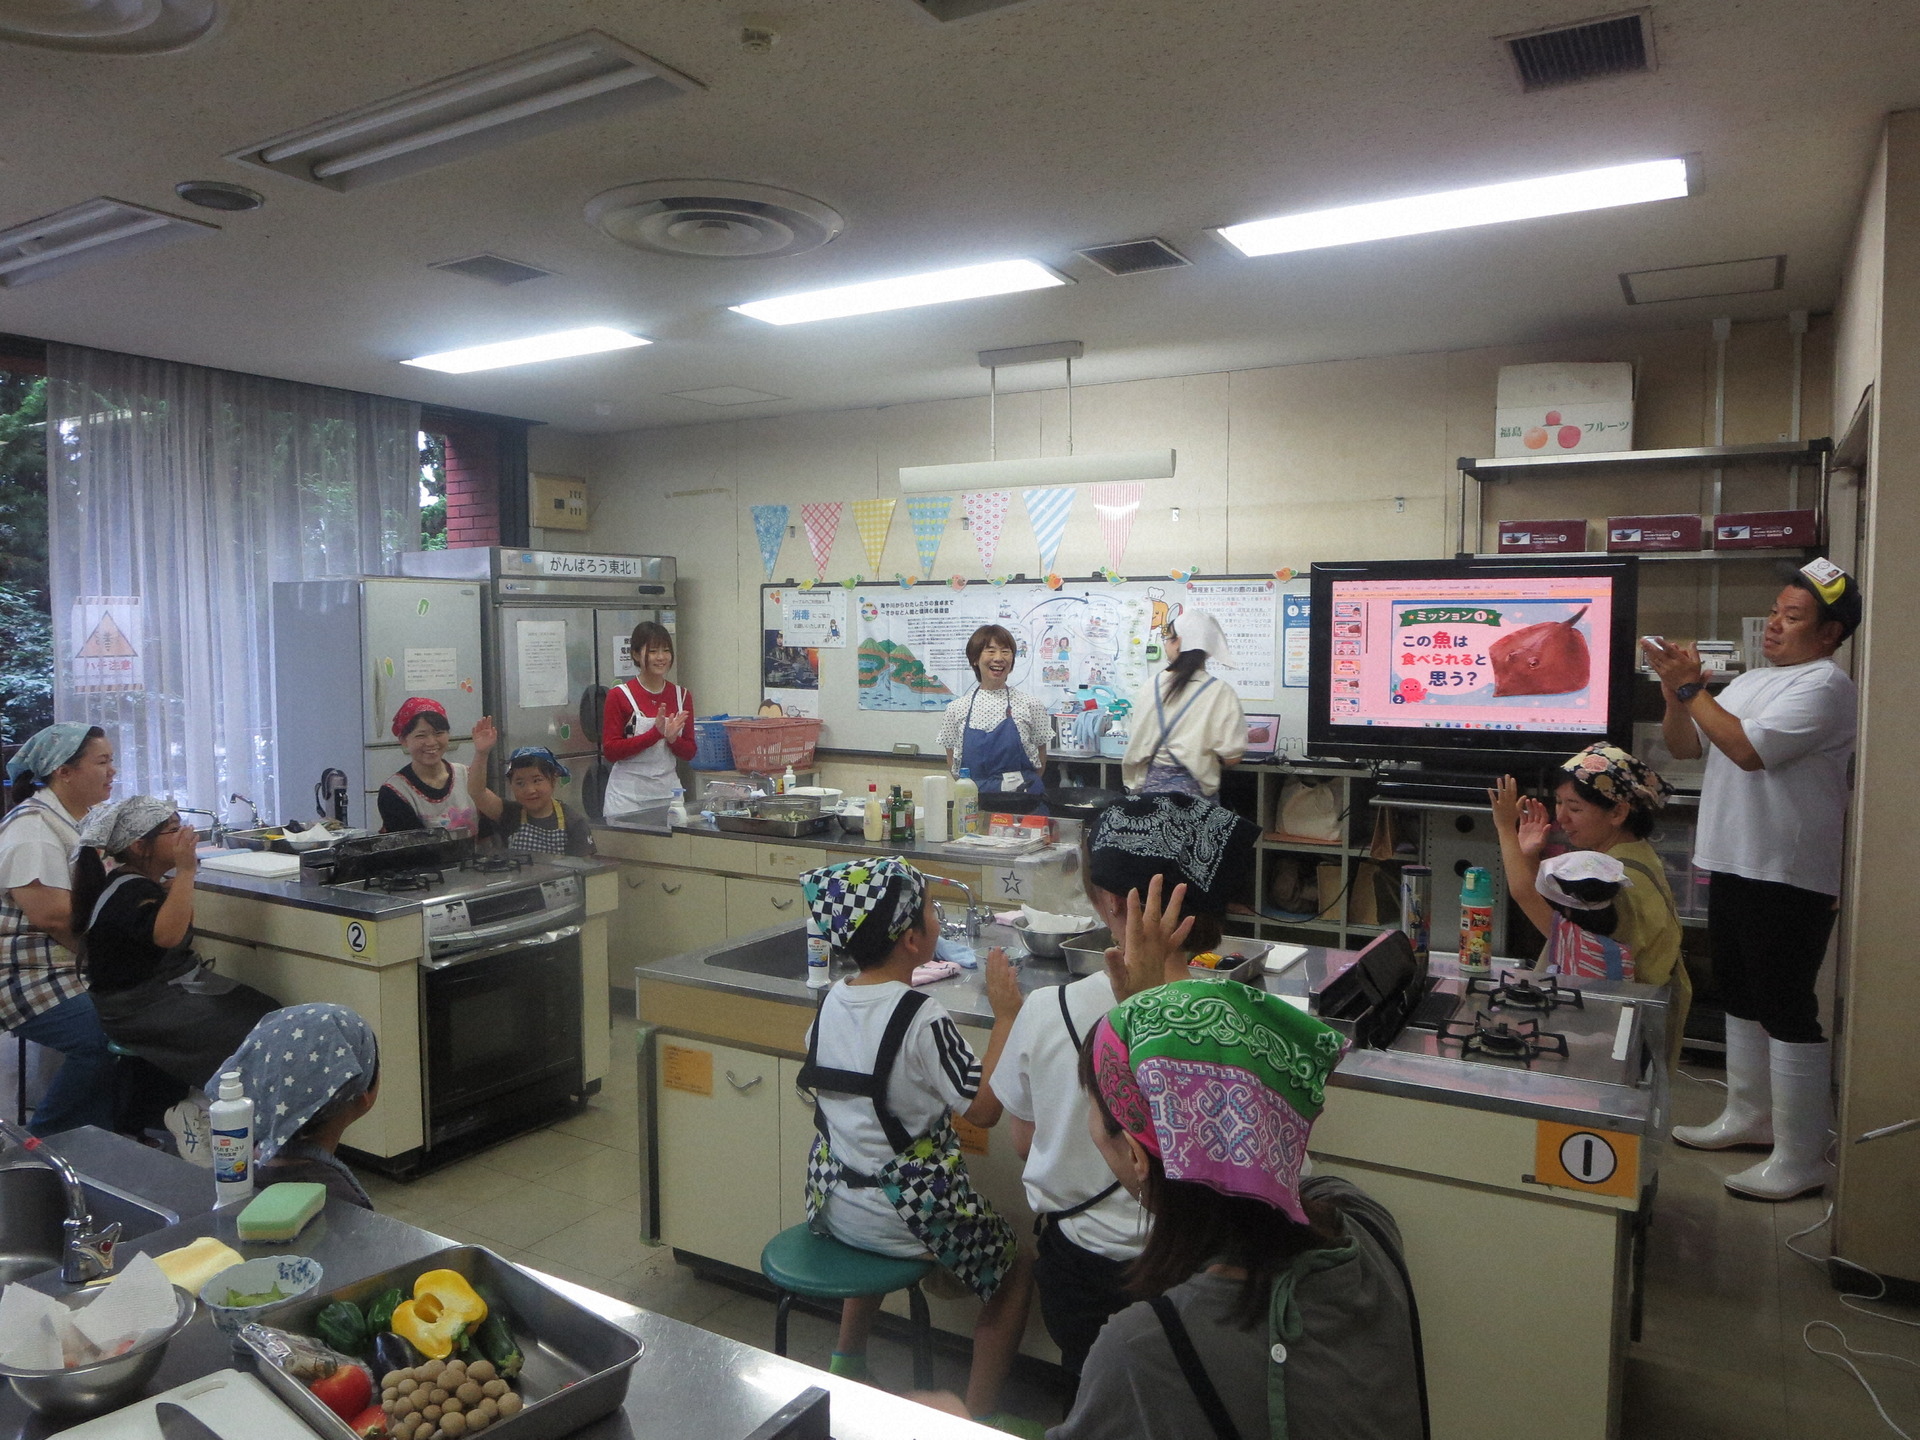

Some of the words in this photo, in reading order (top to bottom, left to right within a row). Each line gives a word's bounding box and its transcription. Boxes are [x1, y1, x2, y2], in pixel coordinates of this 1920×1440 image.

[1500, 426, 1522, 438] 福島
[1584, 421, 1629, 432] フルーツ
[550, 558, 637, 574] がんばろう東北！
[1403, 631, 1468, 649] この魚は
[86, 660, 132, 671] ハチ注意
[1401, 652, 1487, 666] 食べられると
